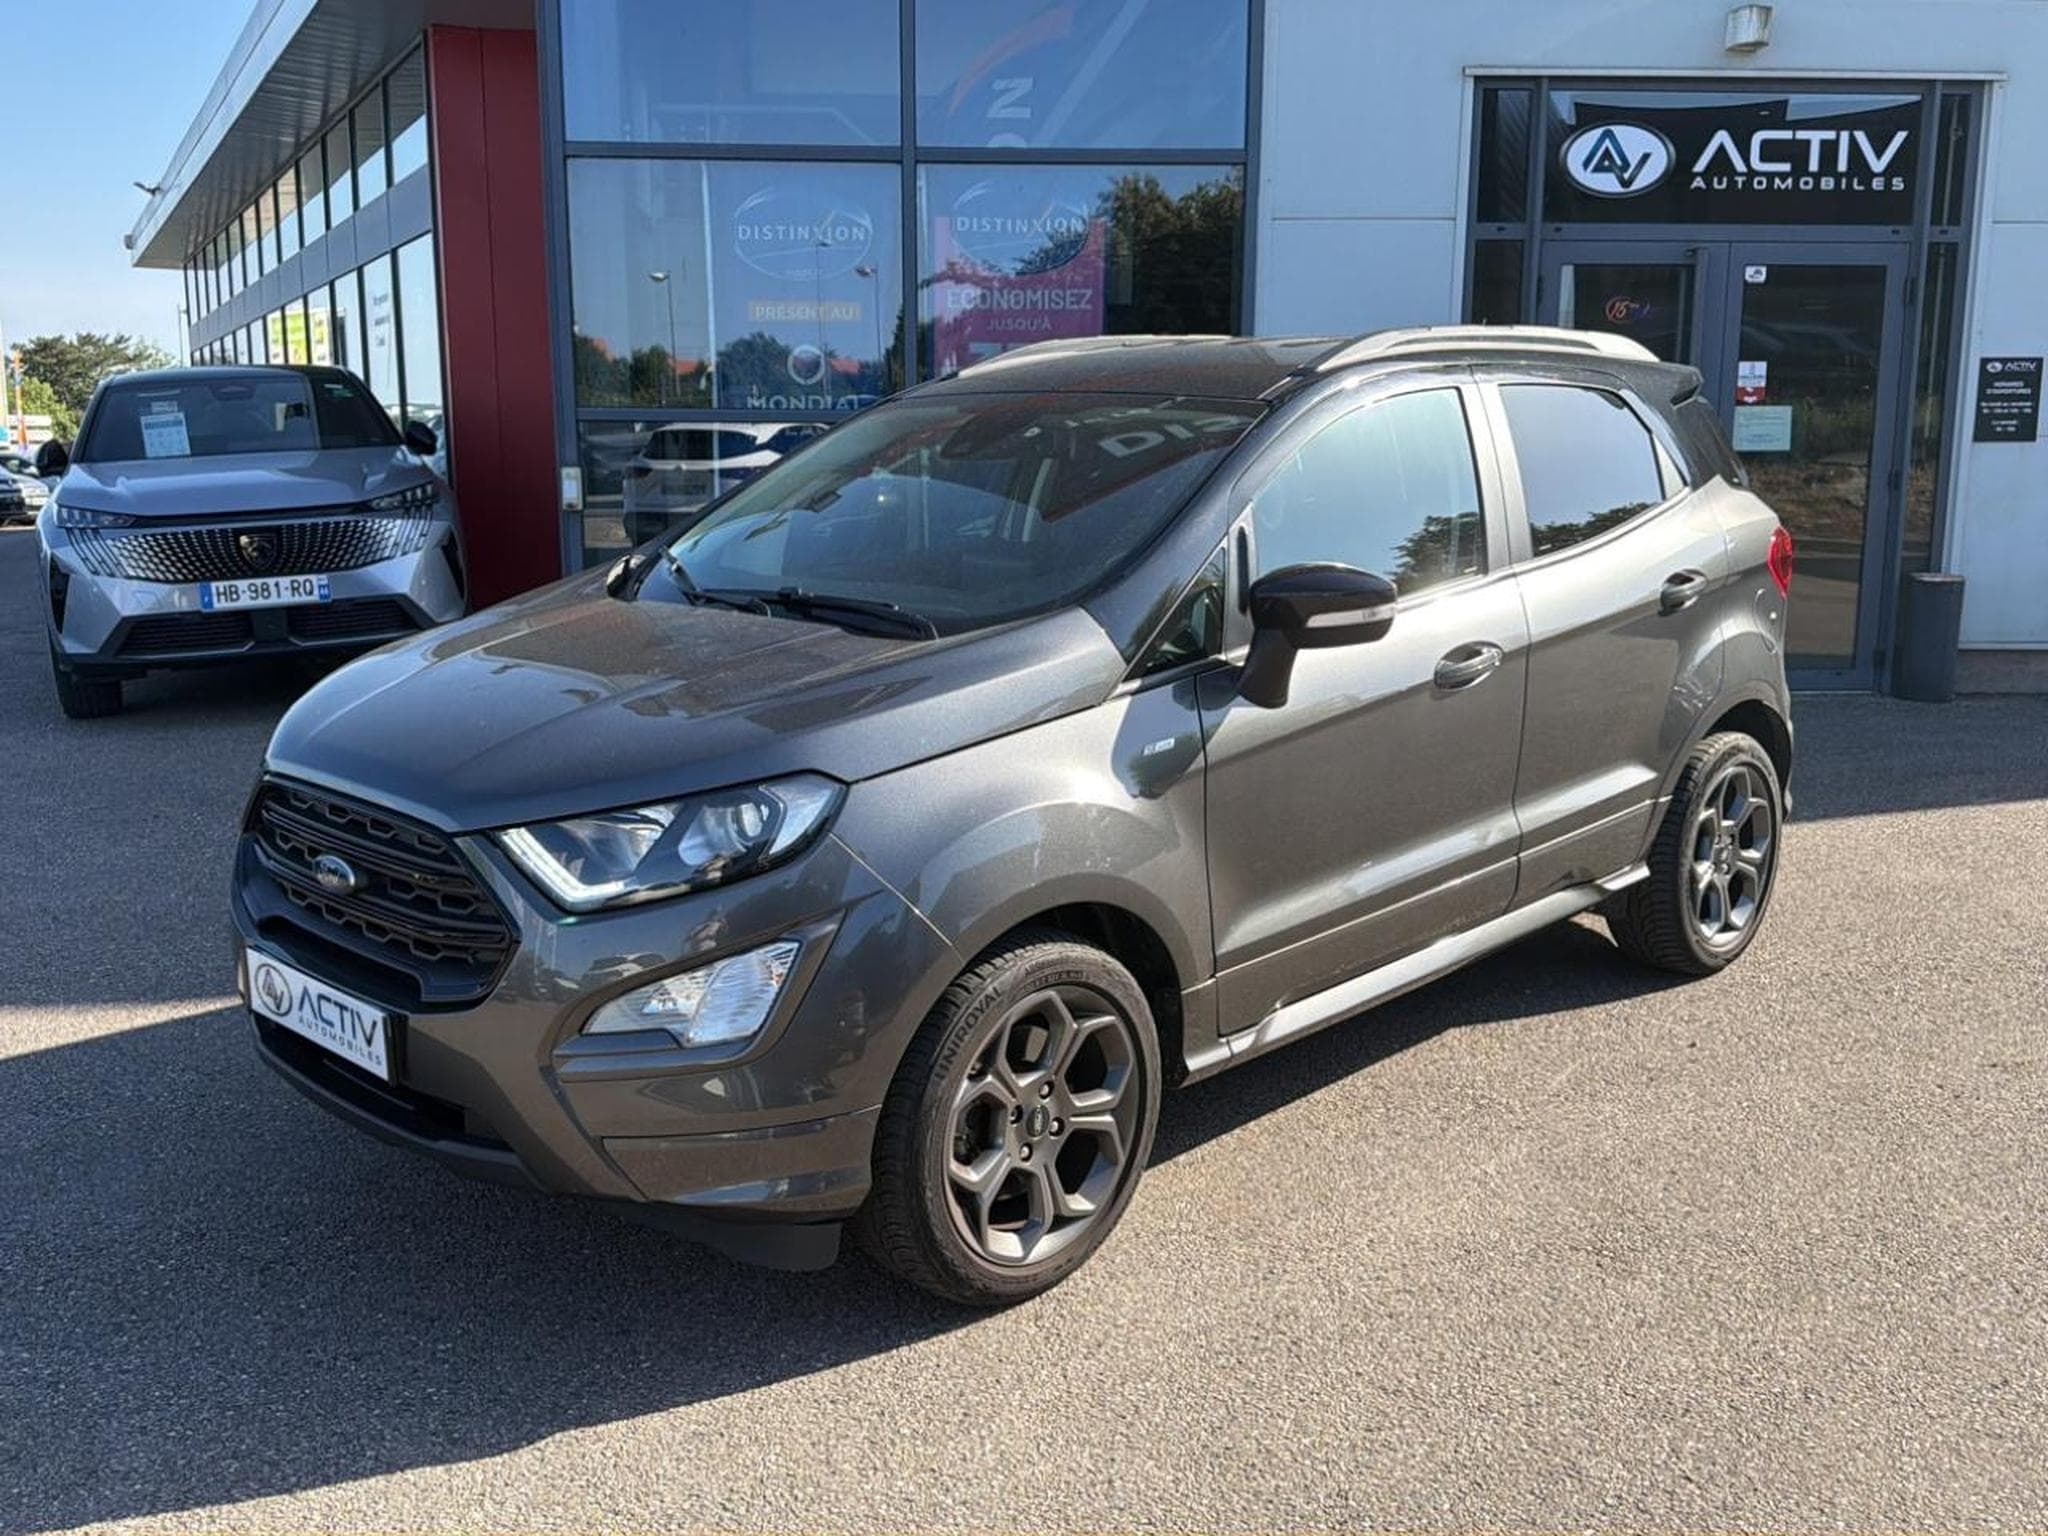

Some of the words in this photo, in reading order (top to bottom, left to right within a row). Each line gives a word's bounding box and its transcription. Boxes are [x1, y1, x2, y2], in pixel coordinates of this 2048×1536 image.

[1692, 129, 1909, 174] ACTIV
[1690, 175, 1906, 191] AUTOMOBILES
[738, 223, 866, 241] DISTINXION
[956, 216, 1083, 234] DISTINXION
[215, 578, 315, 603] HB-981-RQ
[298, 984, 378, 1049] ACTIV
[934, 985, 1004, 1080] UNIROYAL
[299, 1014, 382, 1067] AUTOMOBILES
